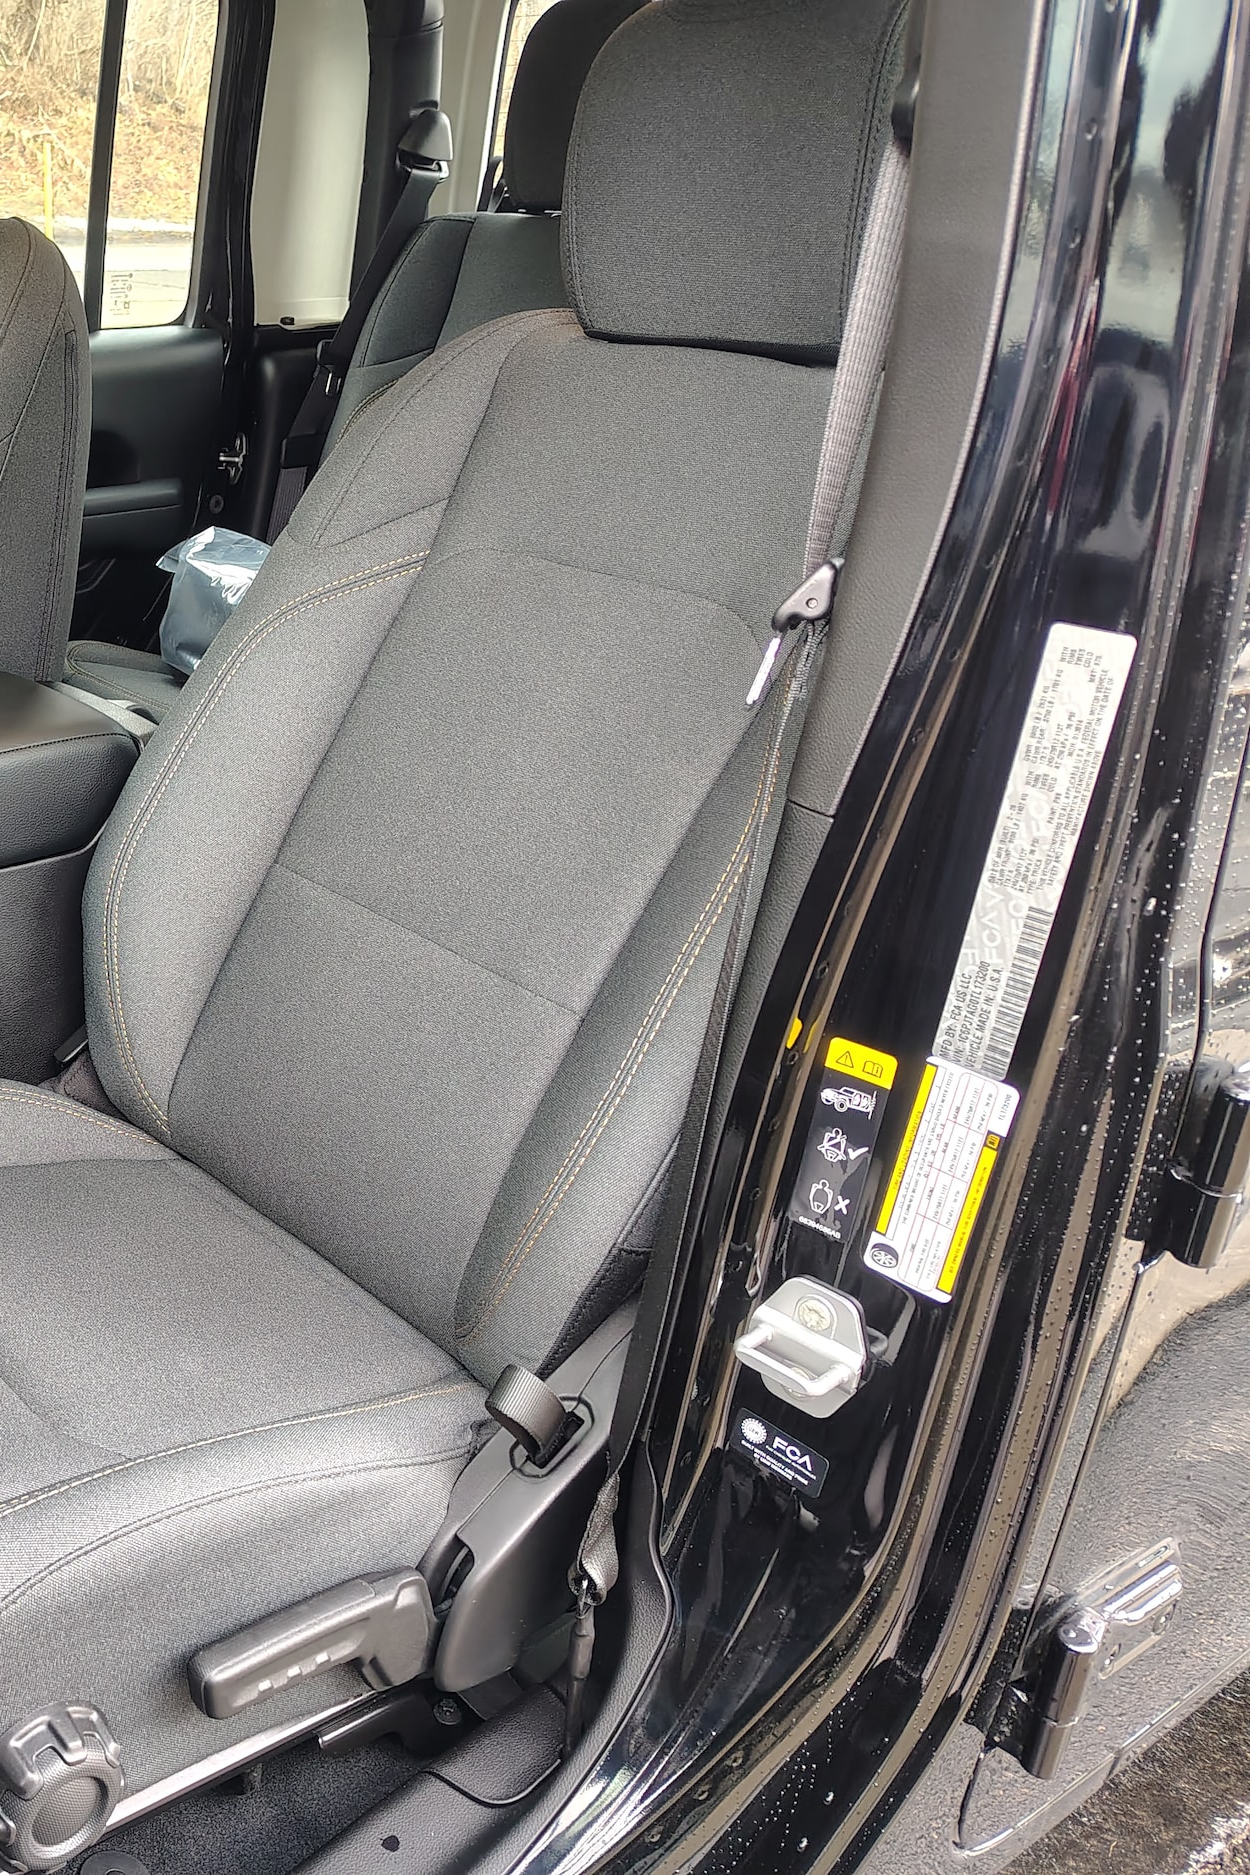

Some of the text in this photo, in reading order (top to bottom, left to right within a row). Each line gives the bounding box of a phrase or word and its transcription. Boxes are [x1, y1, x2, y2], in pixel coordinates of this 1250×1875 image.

[1059, 646, 1070, 663] WITH
[1067, 648, 1077, 664] RIMS
[1075, 648, 1086, 666] TIRES
[1067, 711, 1076, 722] PSI
[1083, 650, 1094, 668] COLD
[1094, 668, 1108, 694] VEHICLE
[1087, 694, 1101, 716] MOTOR
[1100, 686, 1112, 702] DATE
[1096, 703, 1107, 716] THE
[1079, 717, 1094, 744] FEDERAL
[1093, 716, 1103, 726] ON
[1087, 727, 1100, 749] EFFECT
[1024, 770, 1034, 786] WITH
[1047, 776, 1057, 792] COLD
[1063, 764, 1080, 800] APPLICABLE
[1073, 758, 1090, 794] STANDARDS
[1059, 800, 1069, 811] ALL
[1063, 794, 1080, 830] PREVENTION
[1069, 792, 1089, 836] MANUFACTURE
[1082, 770, 1095, 792] SHOWN
[1056, 812, 1066, 821] TO
[1047, 821, 1063, 852] CONFORMS
[1057, 830, 1069, 850] THEFT
[1031, 858, 1042, 877] TRUCK
[1040, 853, 1054, 877] VEHICLE
[1053, 850, 1063, 863] AND
[1036, 876, 1047, 891] THIS
[1046, 864, 1059, 886] SAFETY
[938, 971, 972, 1059] MFD BY: FCA US LLC
[964, 964, 1004, 1069] VEHICLE MADE IN: U.S.A.
[951, 1044, 966, 1064] VIN:
[741, 1440, 754, 1450] BUILT
[754, 1448, 766, 1458] WITH
[766, 1454, 786, 1470] QUALITY
[772, 1436, 812, 1472] FCA
